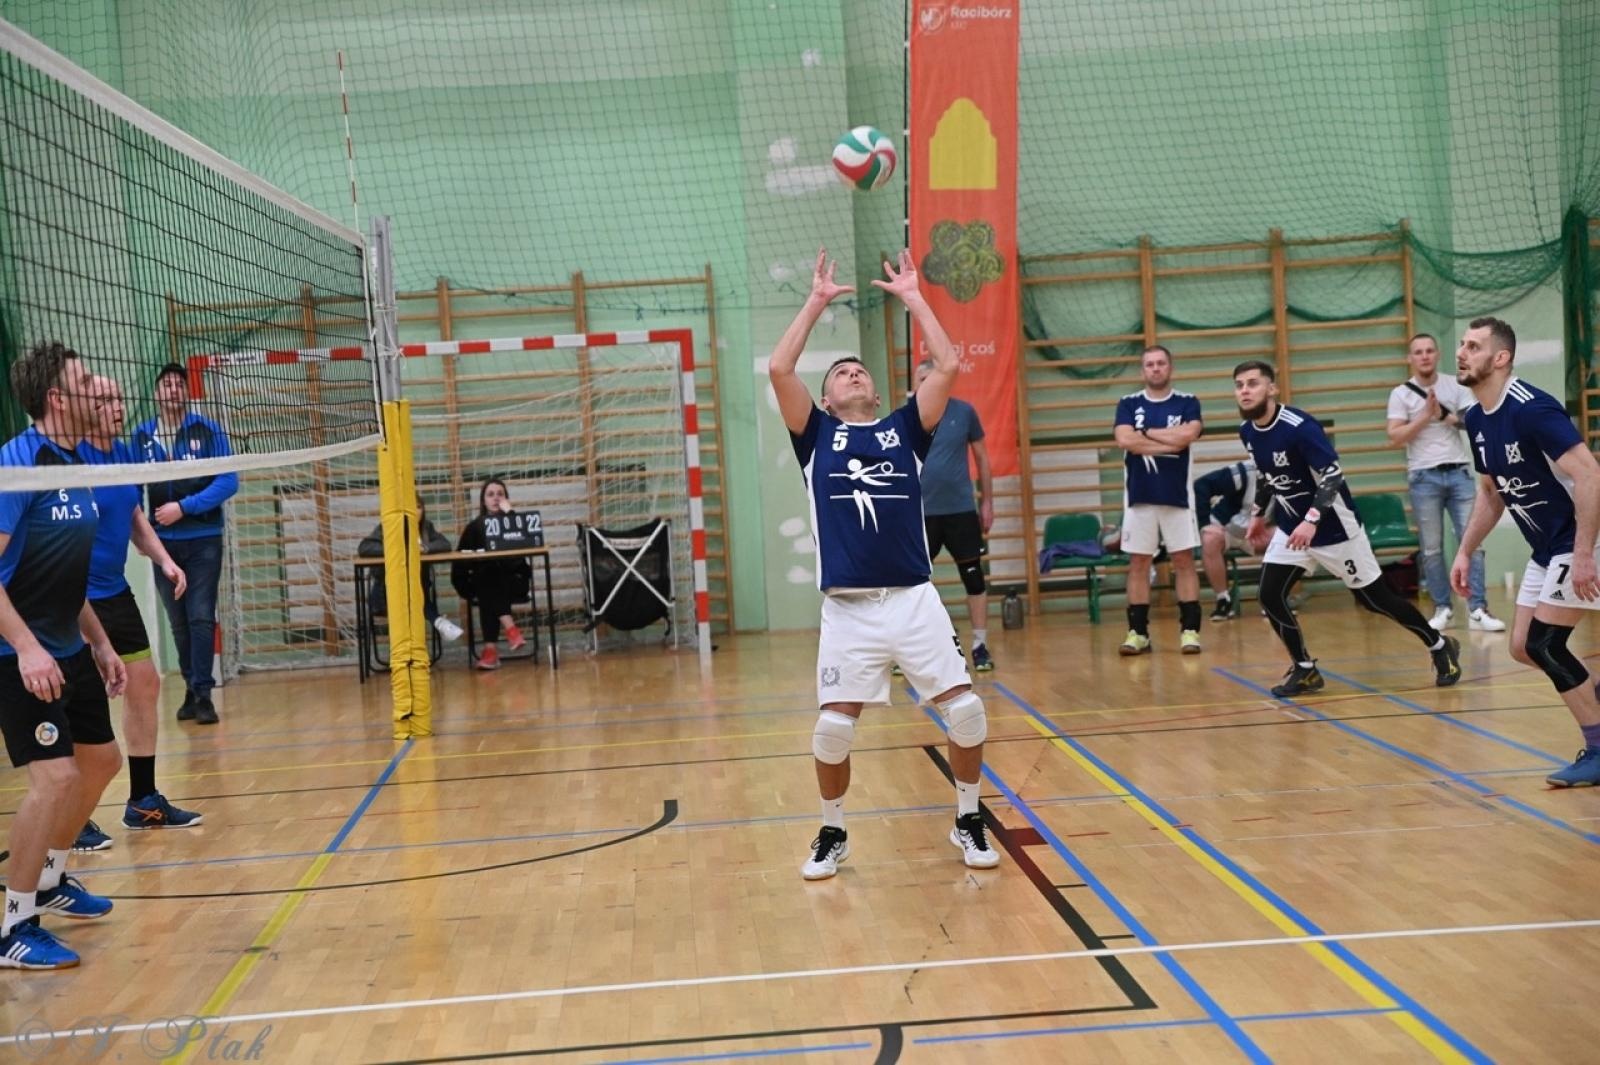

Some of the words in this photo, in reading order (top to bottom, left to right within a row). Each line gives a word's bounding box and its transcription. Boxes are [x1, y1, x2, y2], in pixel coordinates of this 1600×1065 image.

[950, 6, 1012, 18] Racibórz
[1134, 414, 1145, 429] 2
[832, 431, 849, 452] 5
[58, 488, 69, 503] 6
[51, 504, 82, 520] M.S
[484, 518, 500, 536] 20
[503, 516, 510, 529] 0
[515, 515, 523, 529] 0
[526, 514, 542, 532] 22
[1344, 559, 1357, 576] 3
[1556, 563, 1570, 585] 7
